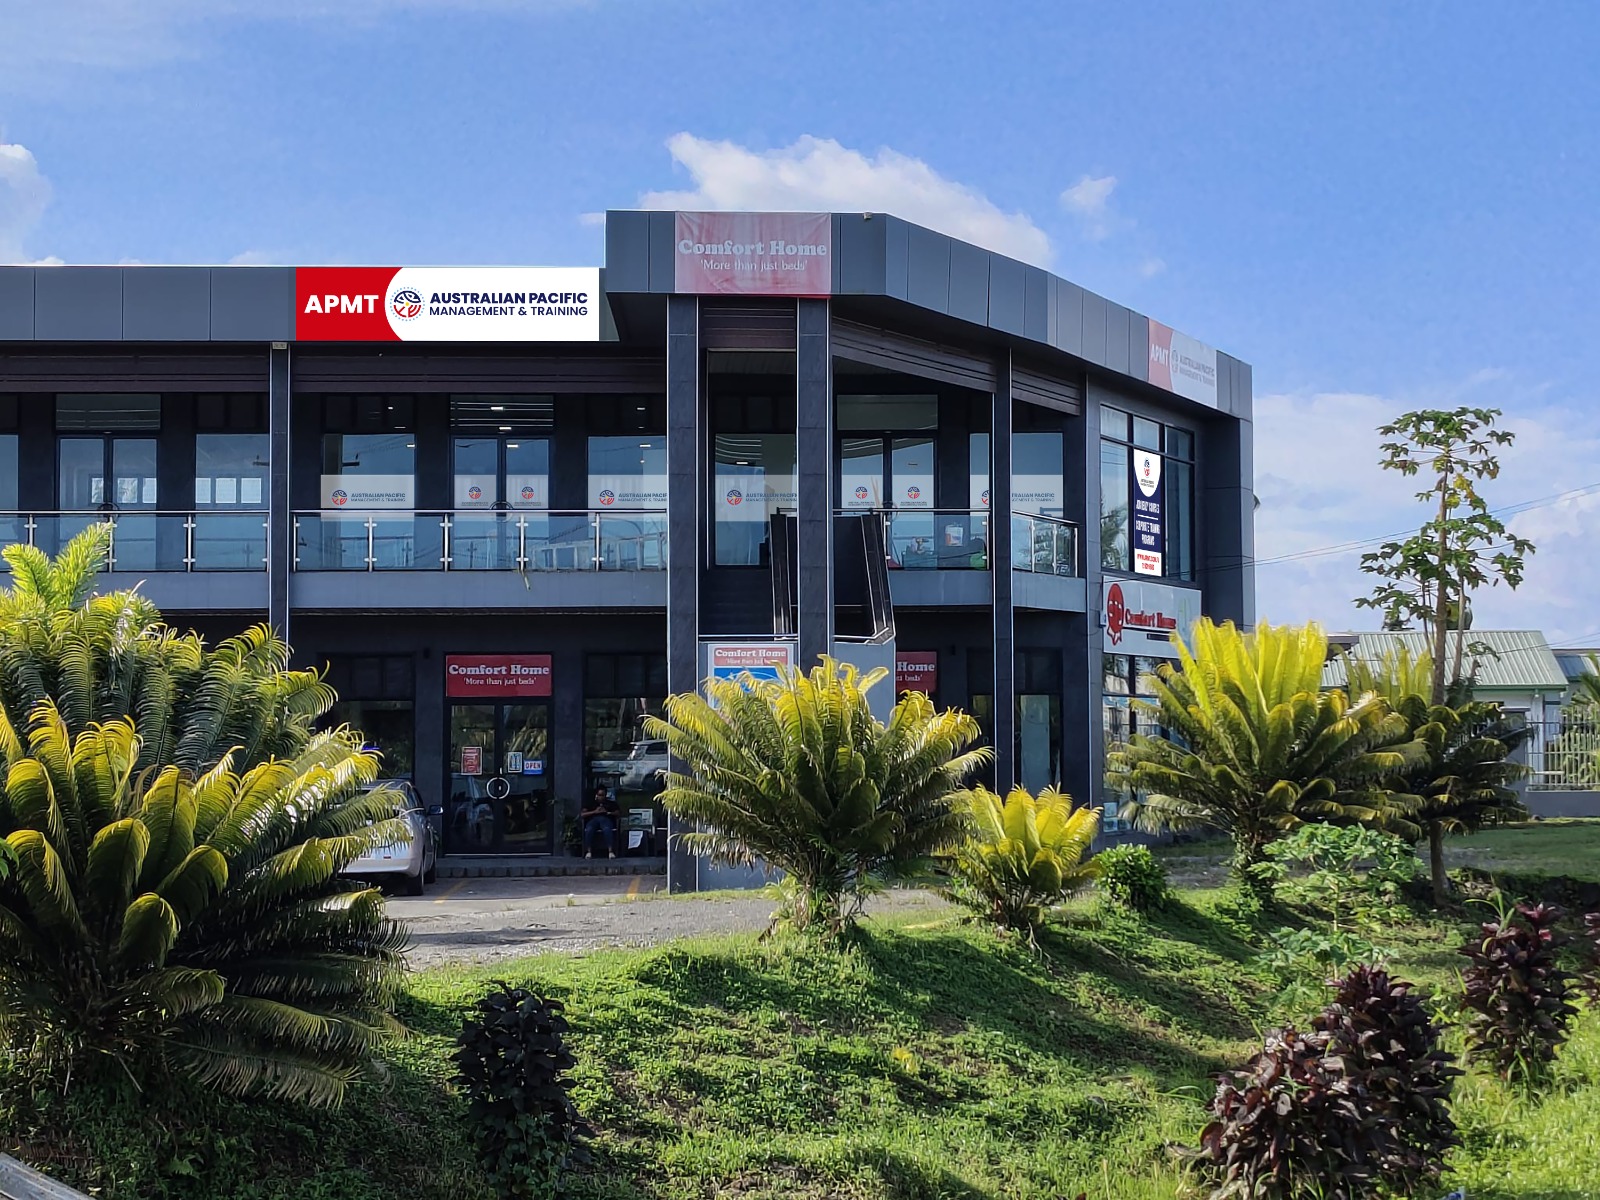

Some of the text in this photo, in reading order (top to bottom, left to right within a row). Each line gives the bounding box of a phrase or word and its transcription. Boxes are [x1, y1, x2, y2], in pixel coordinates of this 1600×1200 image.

[677, 239, 827, 256] Comfort Home
[734, 259, 757, 270] than
[760, 259, 778, 272] just
[429, 292, 588, 304] AUSTRALIAN PACIFIC
[304, 294, 379, 314] APMT
[429, 306, 588, 316] MANAGEMENT & TRAINING
[715, 649, 787, 657] Comfort Home
[448, 664, 550, 675] Comfort Home
[896, 661, 935, 671] Home
[486, 677, 502, 685] than
[504, 677, 516, 686] just
